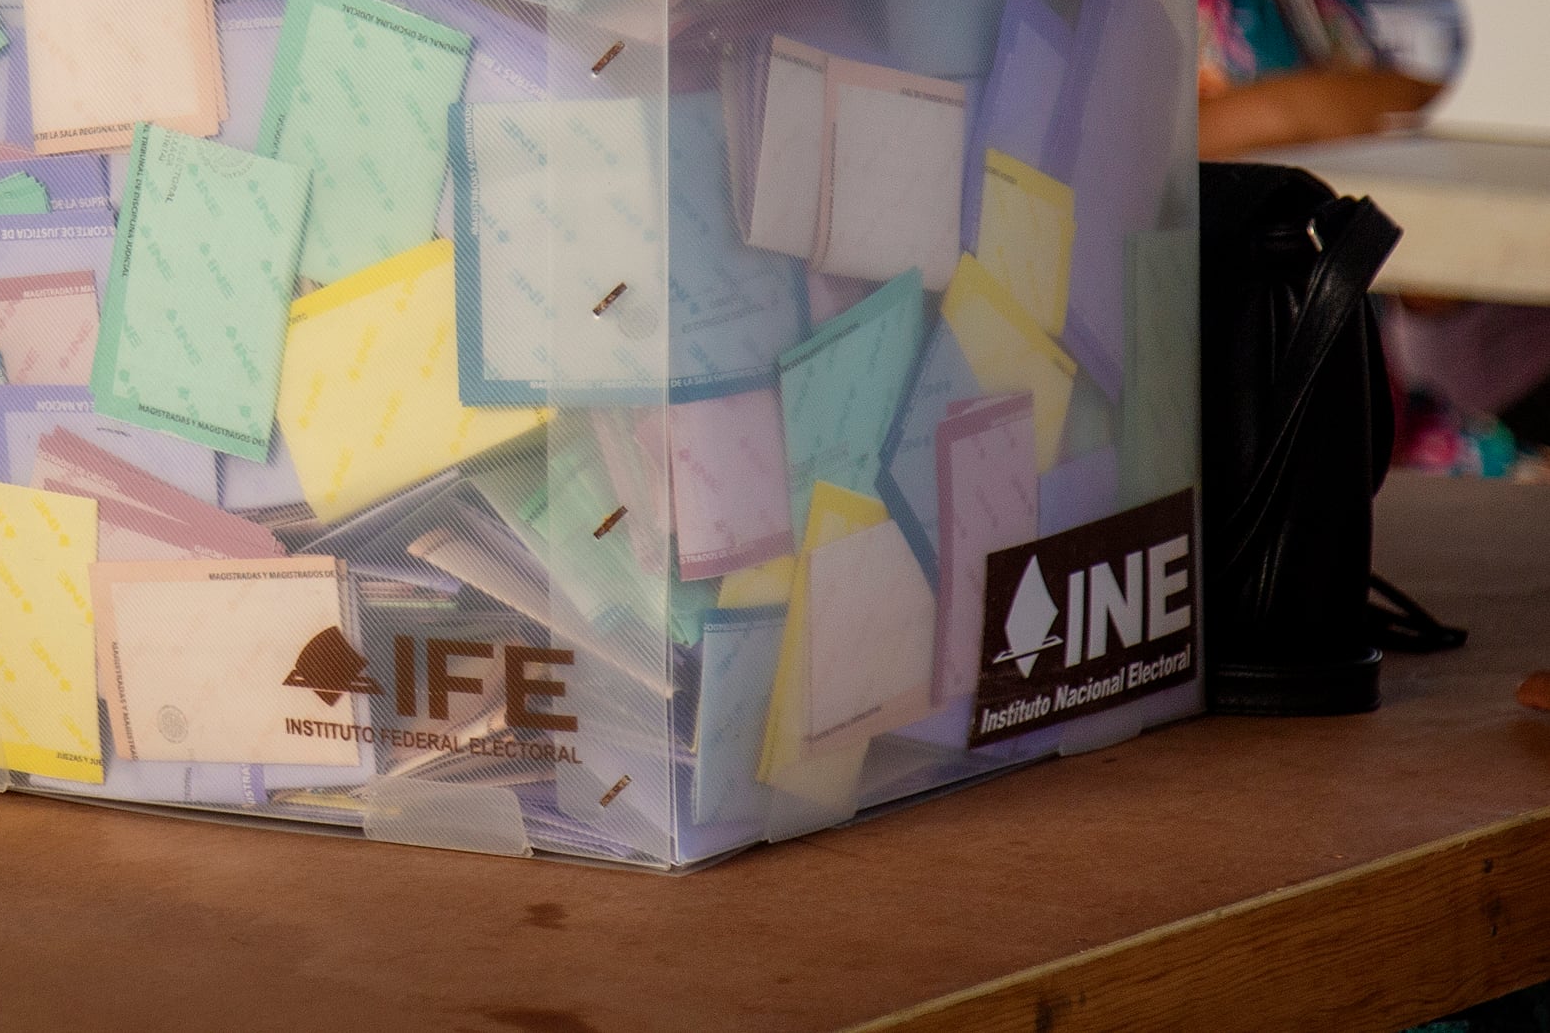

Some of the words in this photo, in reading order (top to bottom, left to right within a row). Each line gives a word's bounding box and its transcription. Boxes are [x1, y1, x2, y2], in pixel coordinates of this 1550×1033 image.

[48, 130, 58, 139] LA
[58, 128, 77, 138] SALA
[465, 102, 476, 162] MAGISTRADO
[136, 135, 148, 177] TRIBUNAL
[15, 227, 59, 239] JUSTICIA
[60, 226, 74, 237] DE
[74, 225, 107, 237] CORTE
[127, 190, 140, 237] DISCIPLINA
[0, 229, 14, 239] DE
[121, 238, 133, 277] JUDICIAL
[669, 378, 682, 388] DE
[136, 402, 191, 425] MAGISTRADAS
[196, 420, 249, 443] MAGISTRADOS
[207, 571, 261, 580] MAGISTRADAS
[268, 570, 323, 579] MAGISTRADOS
[678, 551, 720, 564] STRADOS
[1064, 533, 1191, 668] INE
[393, 634, 579, 733] IFE
[980, 695, 1051, 735] Instituto
[1052, 665, 1126, 713] Nacional
[1126, 643, 1192, 689] Electoral
[122, 712, 138, 761] MAGISTRAD
[284, 717, 377, 744] INSTITUTO
[380, 728, 464, 754] FEDERAL
[469, 737, 584, 765] ELECTORAL
